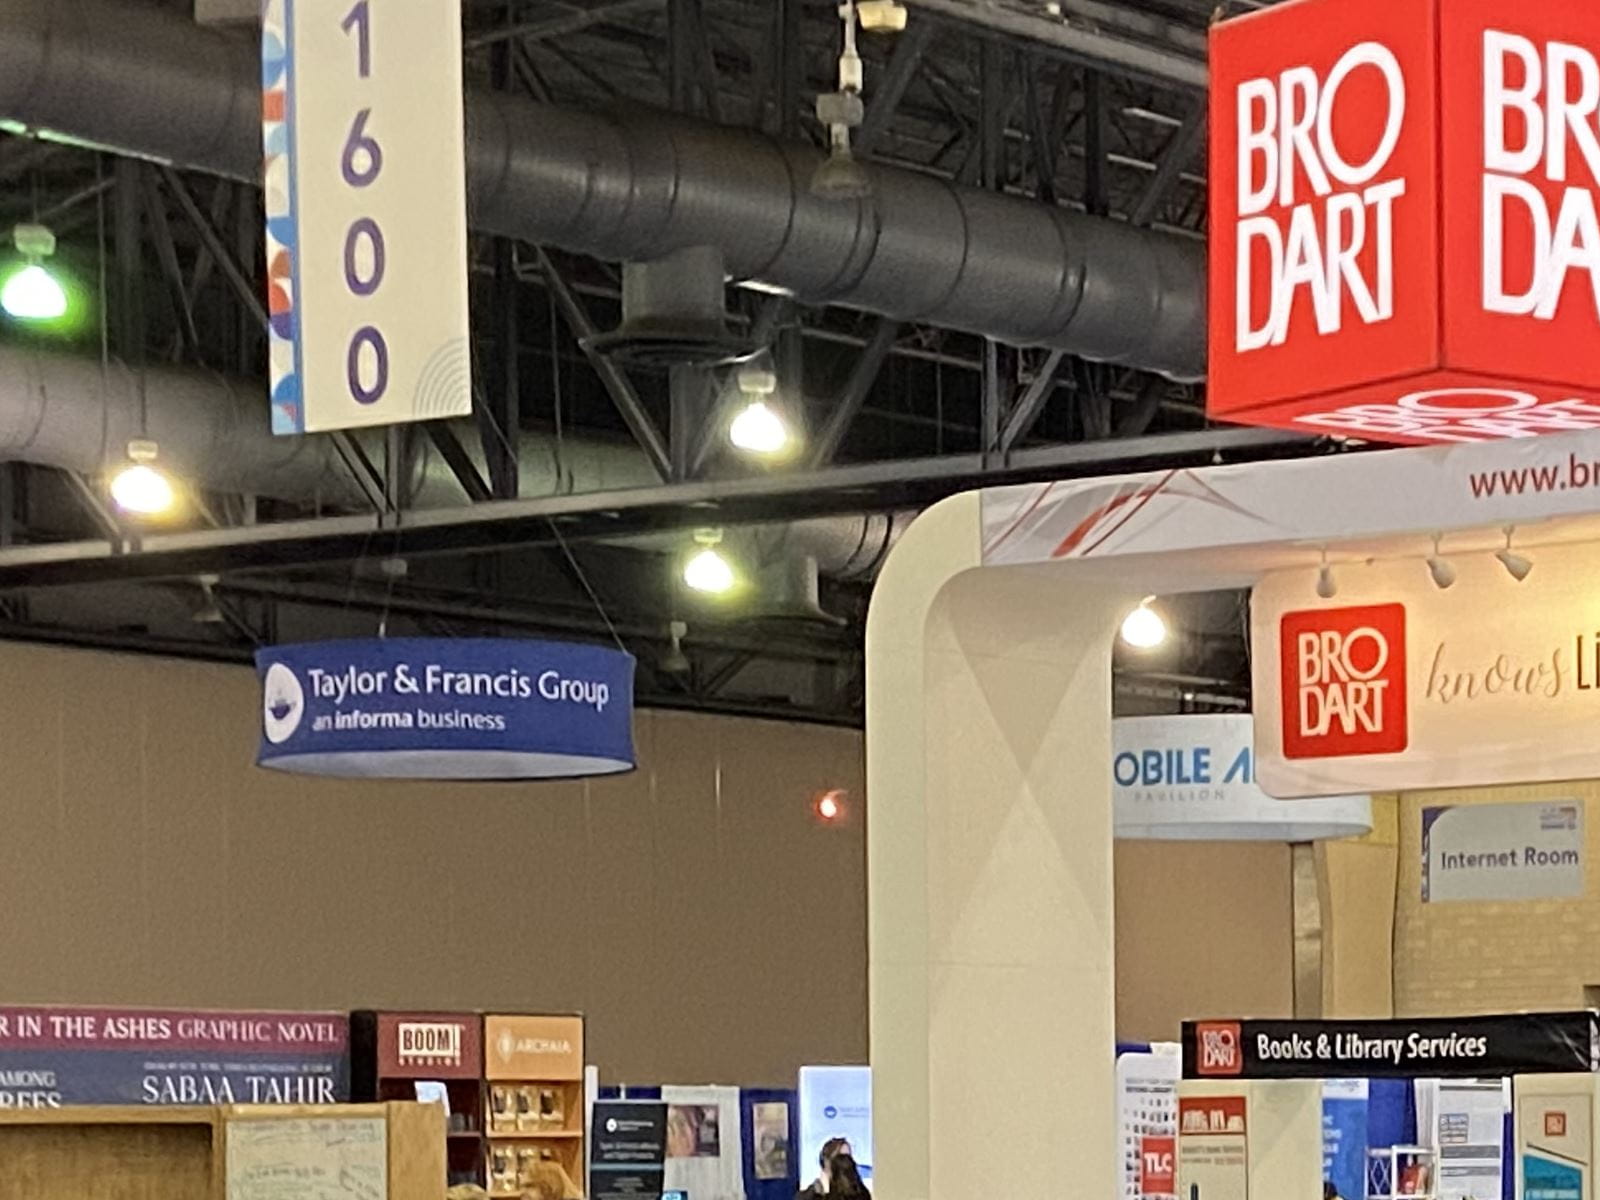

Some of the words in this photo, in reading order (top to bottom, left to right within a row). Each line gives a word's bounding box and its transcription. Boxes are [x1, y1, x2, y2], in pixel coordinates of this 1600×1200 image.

[1237, 42, 1406, 217] BRO
[1236, 178, 1406, 353] DART
[1300, 626, 1388, 685] BRO
[1425, 639, 1570, 704] knows
[308, 665, 388, 702] Taylor
[393, 665, 420, 693] &
[425, 665, 530, 699] Francis
[538, 672, 609, 711] Group
[312, 714, 332, 730] an
[335, 708, 413, 729] informa
[417, 708, 505, 730] business
[1300, 679, 1389, 738] DART
[1223, 746, 1256, 784] A
[1441, 849, 1518, 870] Internet
[1524, 846, 1579, 867] Room
[17, 1015, 42, 1037] IN
[50, 1016, 97, 1039] THE
[103, 1017, 171, 1039] ASHES
[178, 1018, 272, 1041] GRAPHIC
[278, 1021, 338, 1043] NOVEL
[1257, 1033, 1313, 1060] Books
[1316, 1033, 1332, 1059] &
[1335, 1033, 1404, 1065] Library
[1407, 1032, 1488, 1059] Services
[142, 1074, 235, 1105] SABAA
[246, 1075, 337, 1105] TAHIR
[1143, 1151, 1173, 1173] TLC
